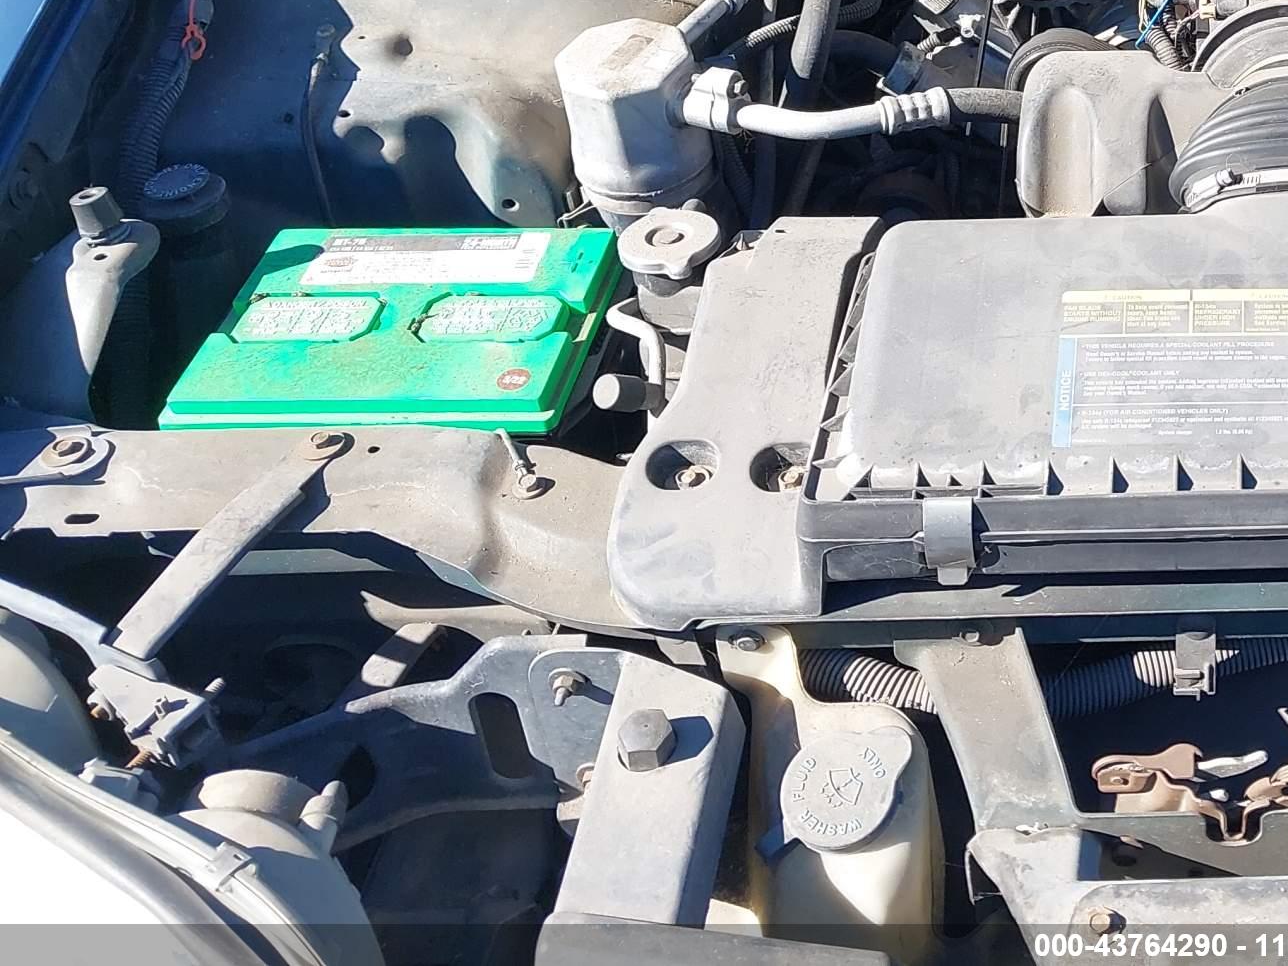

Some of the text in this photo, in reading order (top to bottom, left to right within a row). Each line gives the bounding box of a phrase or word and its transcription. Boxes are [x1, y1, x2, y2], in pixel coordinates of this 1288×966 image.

[1059, 369, 1072, 411] NOTICE
[792, 747, 887, 836] WASHER FLUID ONLY
